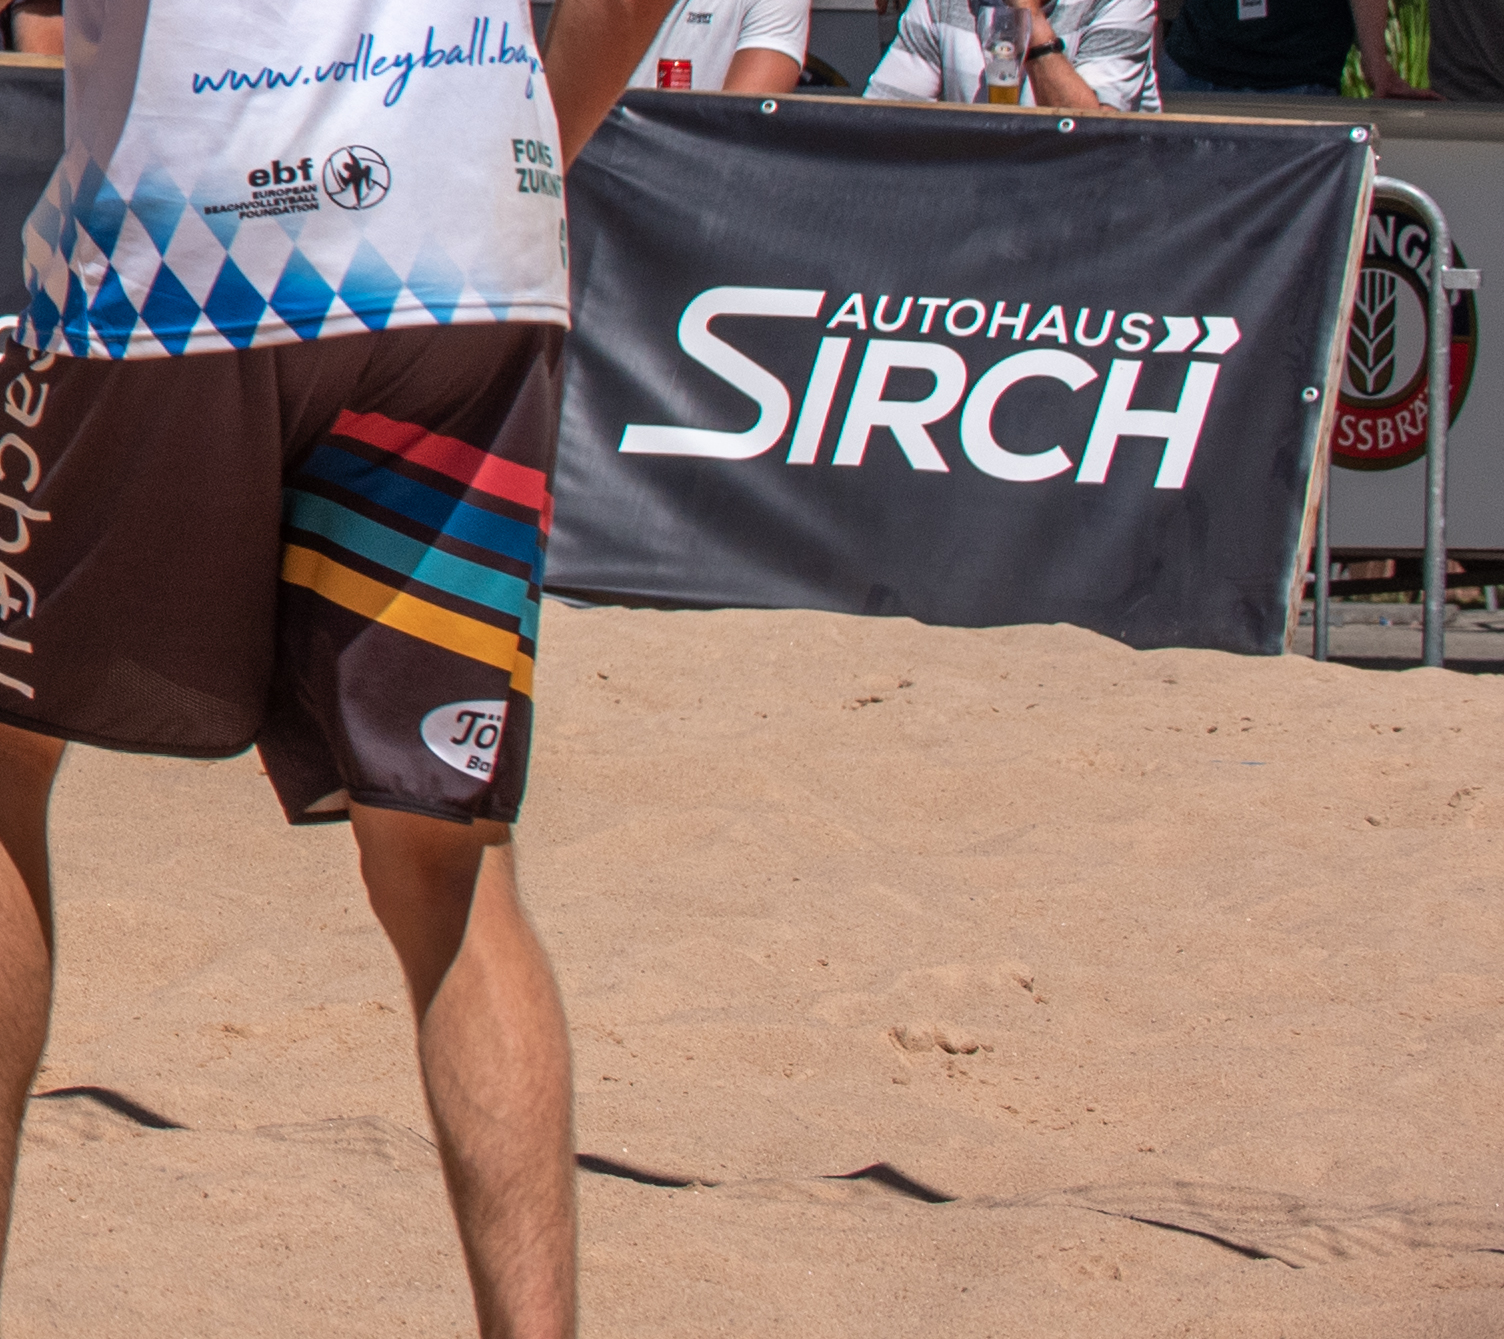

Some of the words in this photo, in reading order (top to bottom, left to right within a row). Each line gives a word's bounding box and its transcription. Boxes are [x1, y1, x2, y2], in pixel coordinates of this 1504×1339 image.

[247, 157, 314, 188] ebf
[251, 183, 318, 201] EUROPEAN
[826, 291, 1156, 352] AUTOHAUS
[618, 284, 1221, 491] SIRCH
